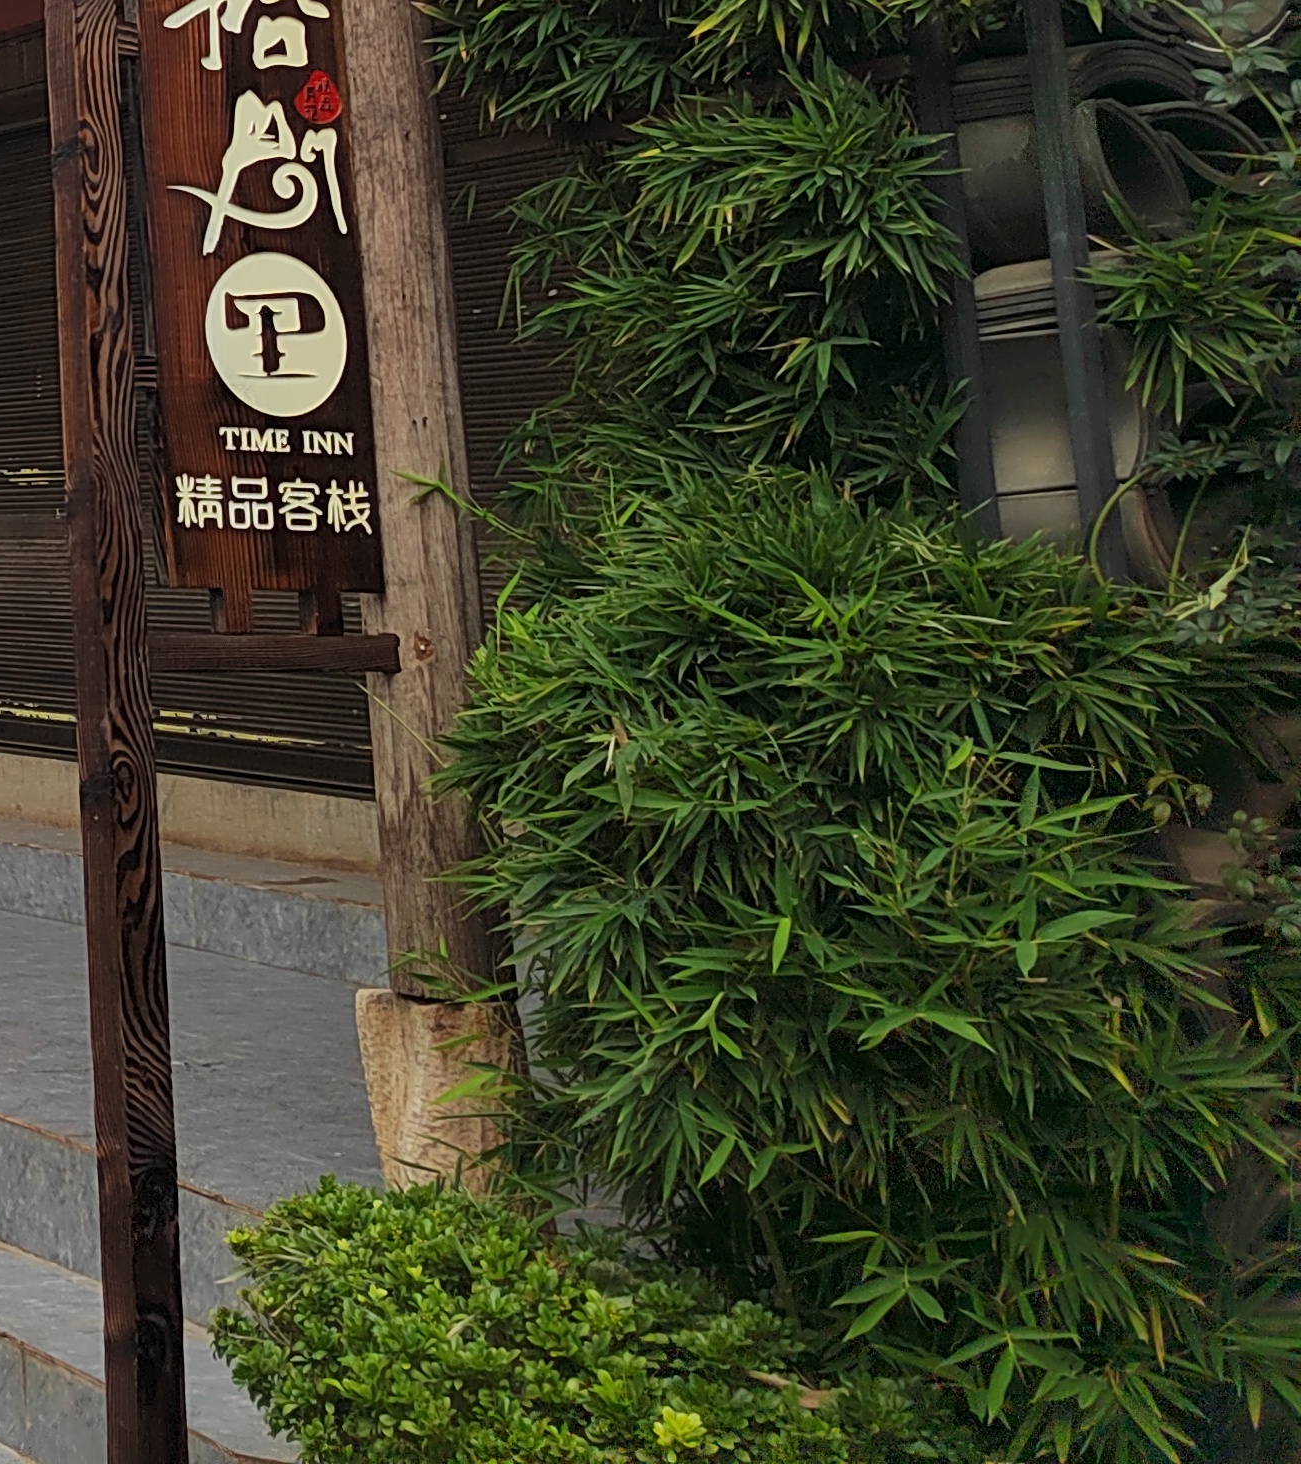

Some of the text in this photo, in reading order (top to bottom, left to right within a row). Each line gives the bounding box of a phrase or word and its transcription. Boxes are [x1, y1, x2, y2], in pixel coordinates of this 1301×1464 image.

[218, 426, 355, 456] TIME INN
[175, 472, 373, 535] 精品客栈
